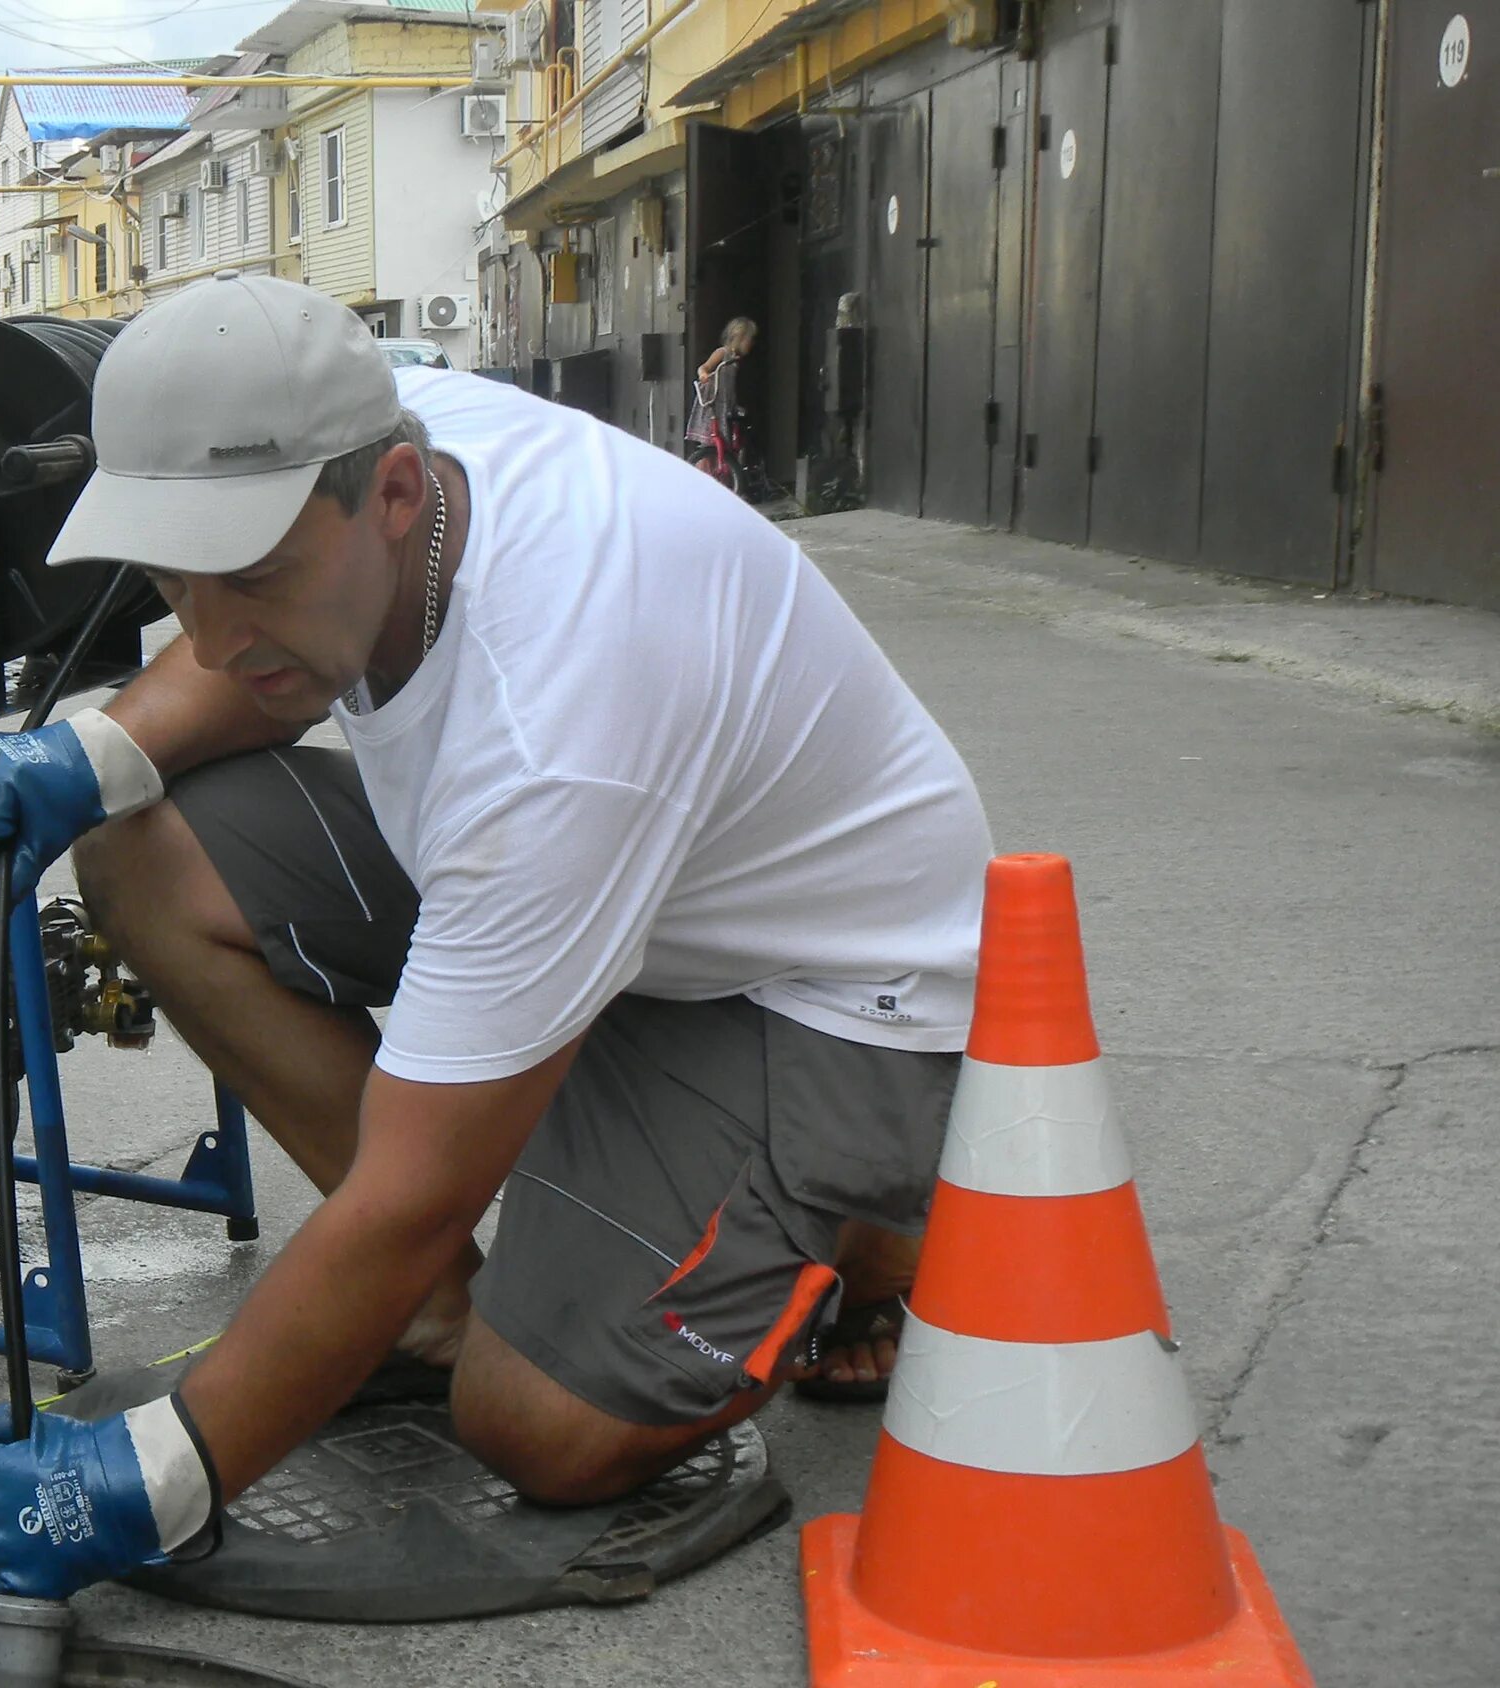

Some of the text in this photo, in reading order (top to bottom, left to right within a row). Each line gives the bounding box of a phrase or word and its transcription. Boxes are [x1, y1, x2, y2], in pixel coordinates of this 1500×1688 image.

[1444, 39, 1465, 67] 119
[678, 1325, 735, 1363] MODYF
[35, 1482, 61, 1545] INTERTOOL
